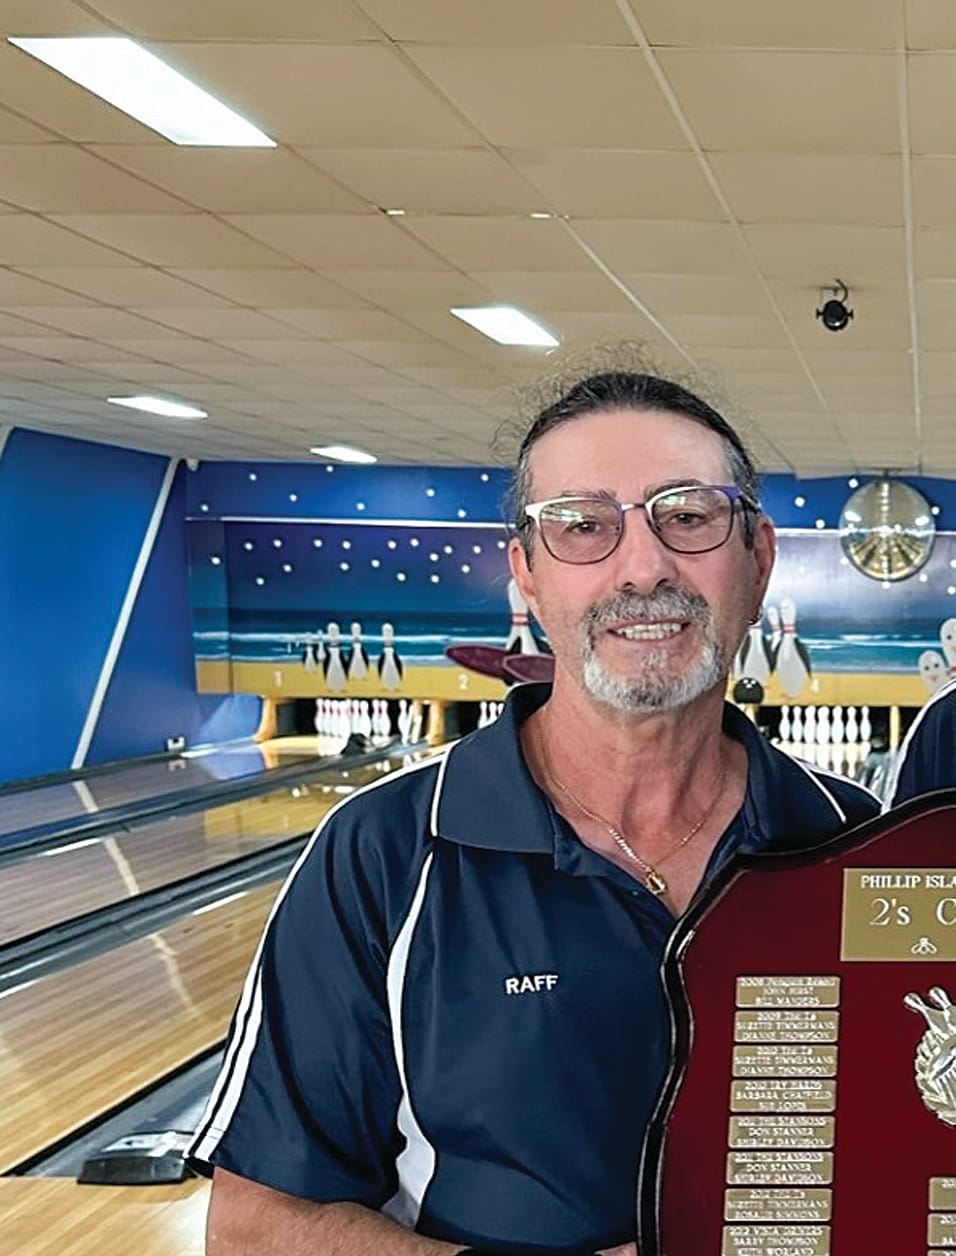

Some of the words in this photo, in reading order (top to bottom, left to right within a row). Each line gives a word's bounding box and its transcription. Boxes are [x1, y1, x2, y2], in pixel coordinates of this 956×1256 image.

[274, 673, 282, 686] 1
[458, 675, 469, 689] 2
[860, 874, 921, 889] PHILLIP
[869, 897, 911, 926] 2's
[505, 974, 559, 994] RAFF
